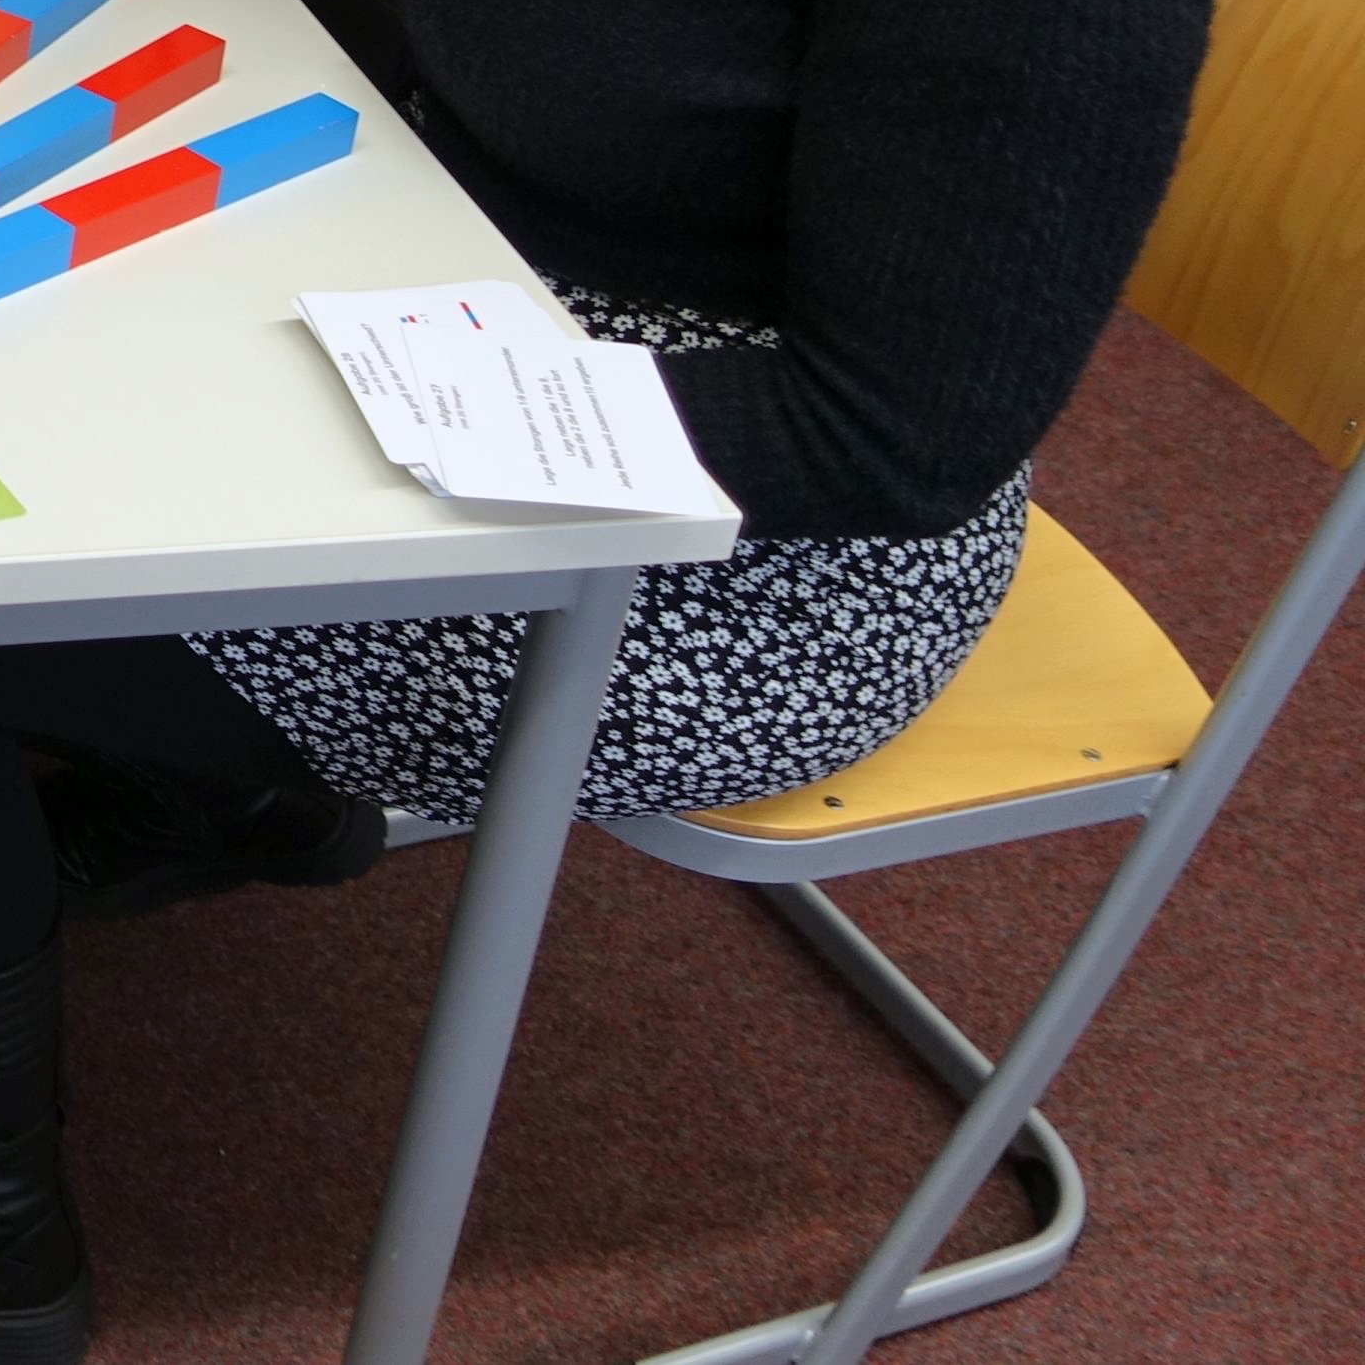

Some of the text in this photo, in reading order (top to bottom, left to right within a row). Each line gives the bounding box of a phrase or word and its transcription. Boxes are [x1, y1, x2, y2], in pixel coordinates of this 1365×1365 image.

[349, 363, 373, 395] Aufgabe
[388, 369, 402, 382] der
[542, 384, 553, 395] die
[556, 383, 566, 392] so
[558, 393, 571, 406] und
[436, 395, 452, 428] Aufgabe
[522, 407, 533, 420] von
[549, 402, 559, 414] die
[588, 394, 610, 432] zusammen
[412, 411, 427, 425] Wie
[568, 414, 578, 425] die
[553, 415, 567, 437] neben
[527, 422, 545, 452] Stangen
[575, 433, 586, 444] die
[602, 434, 616, 447] soll
[563, 438, 576, 457] Lege
[539, 454, 549, 465] die
[579, 446, 594, 469] neben
[610, 449, 624, 469] Reihe
[543, 467, 557, 486] Lege
[619, 471, 633, 489] Jede
